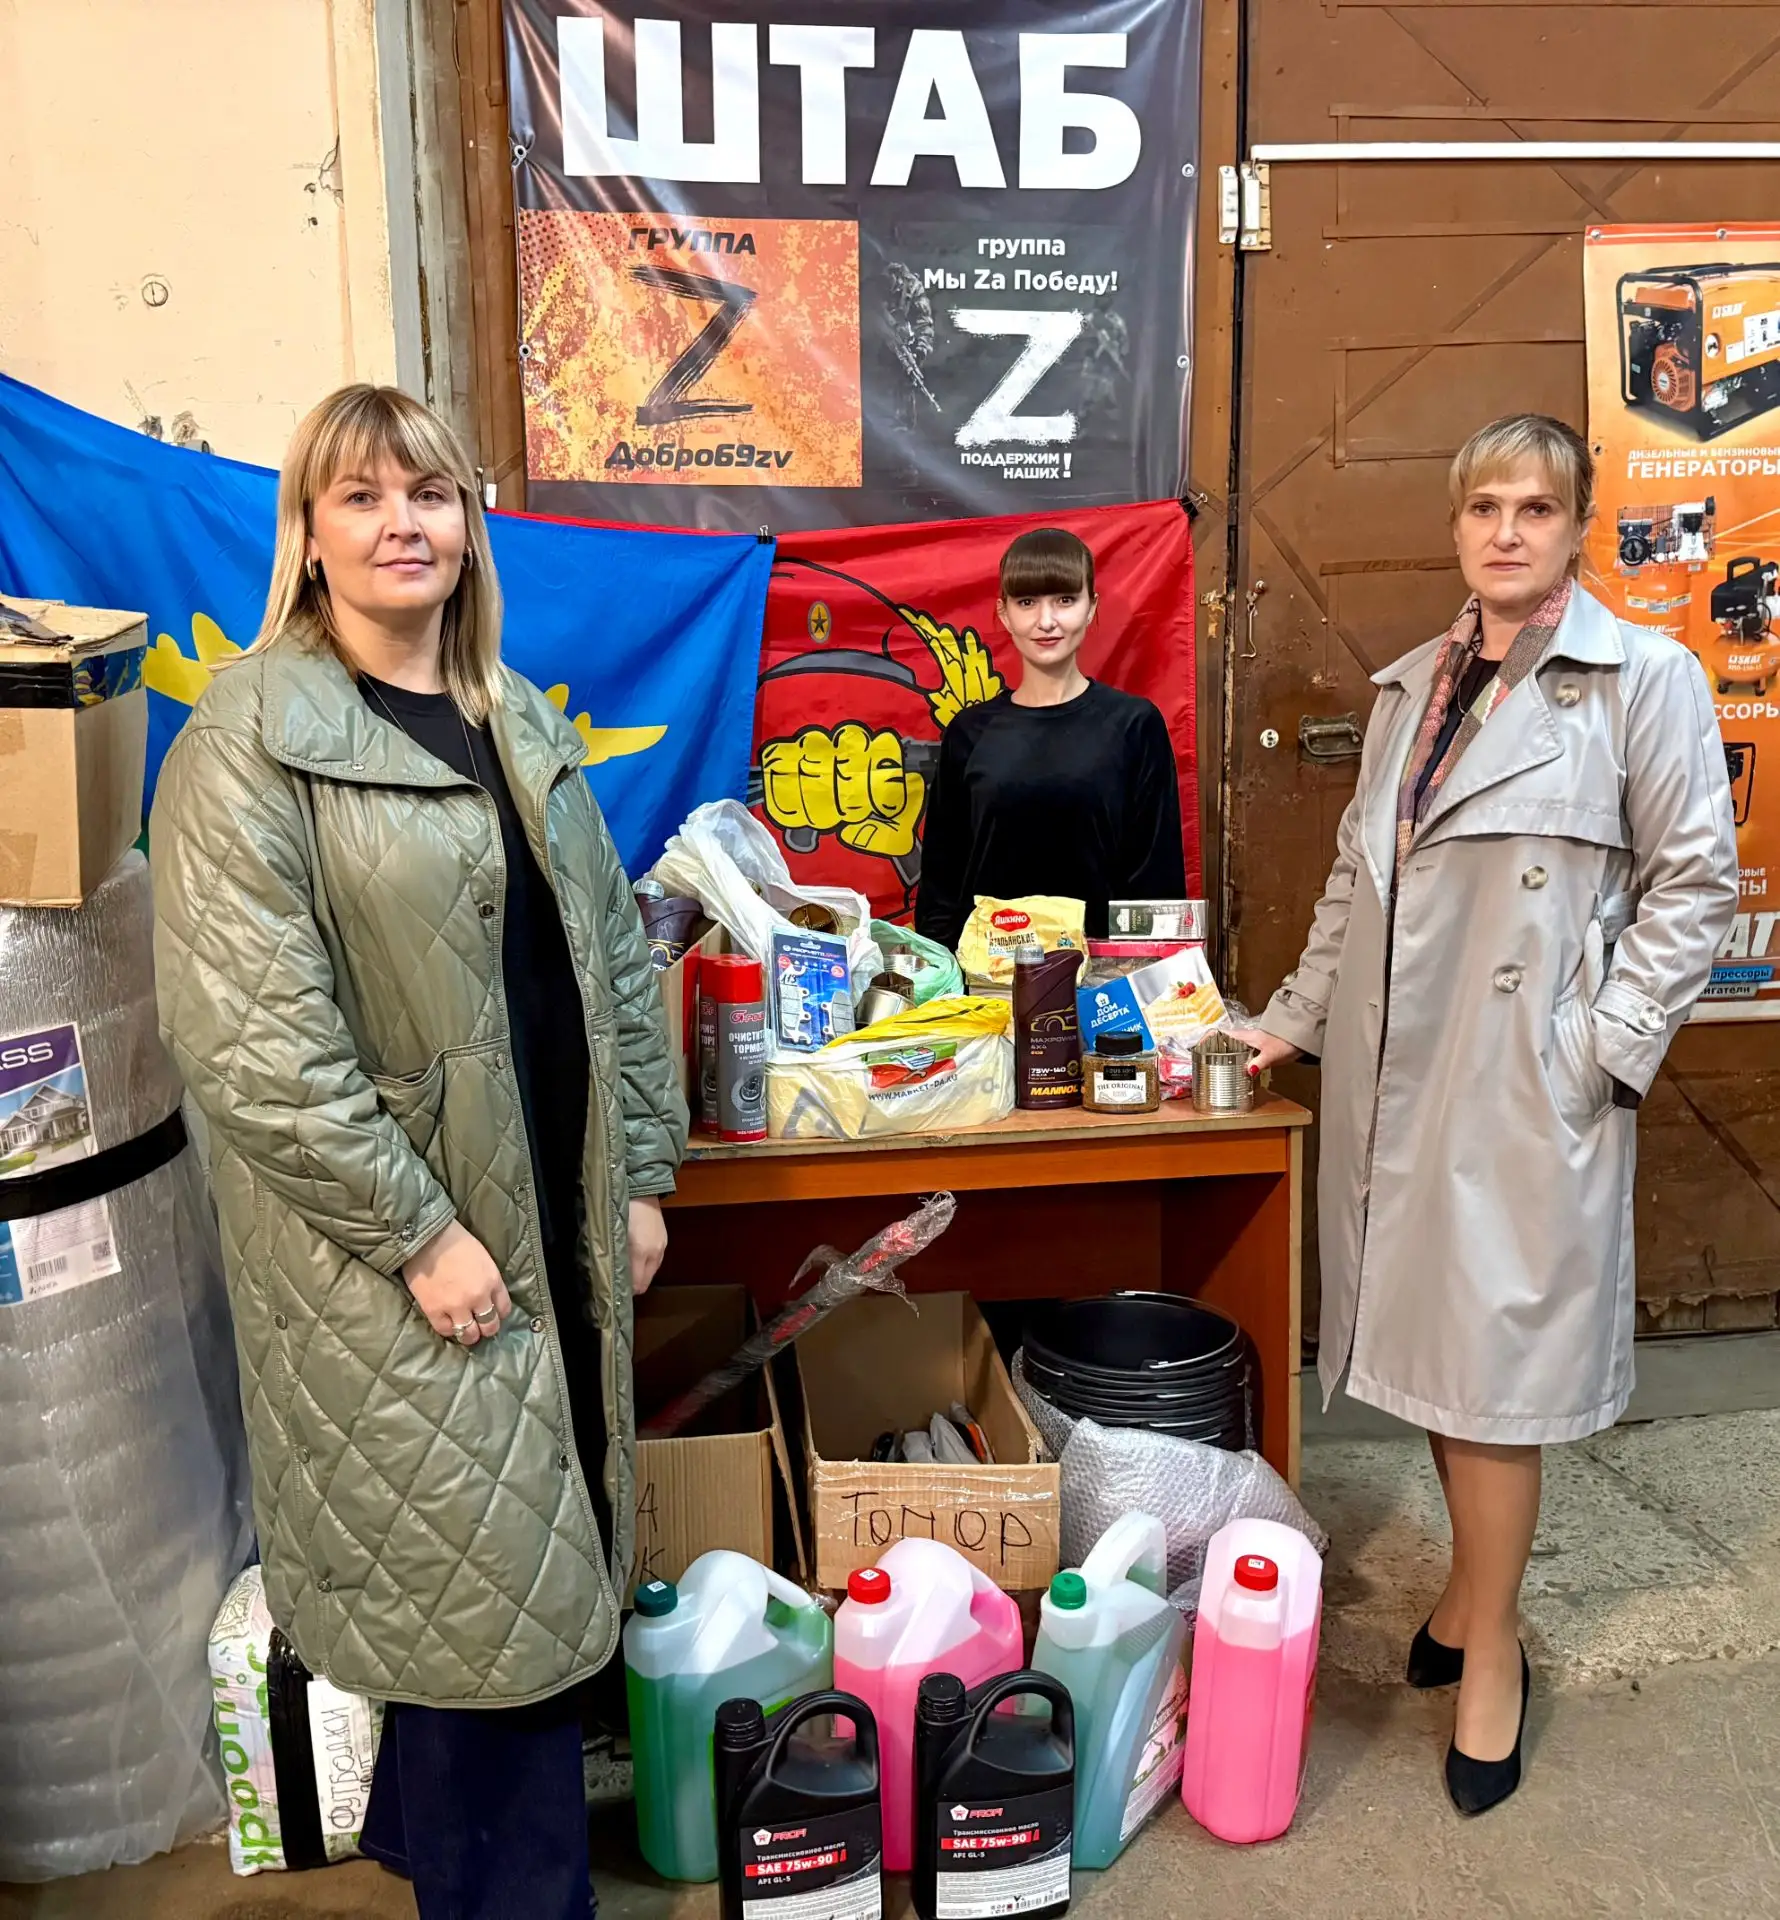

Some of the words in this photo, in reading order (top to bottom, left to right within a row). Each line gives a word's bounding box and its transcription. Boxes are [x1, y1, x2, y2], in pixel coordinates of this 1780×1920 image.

[557, 16, 1141, 189] ШТАБ
[628, 228, 757, 255] ГРУППА
[977, 237, 1066, 259] группа
[923, 268, 966, 290] Мы
[1014, 269, 1119, 295] Победу!
[960, 452, 1060, 466] ПОДДЕРЖИМ
[1003, 467, 1060, 480] НАШИХ
[1097, 1002, 1118, 1017] ДОМ
[1090, 1007, 1131, 1028] ДЕСЕРТА
[1030, 1084, 1079, 1096] MANNOL
[1111, 1082, 1144, 1092] ORIGINAL
[953, 1838, 977, 1849] SAE
[757, 1862, 782, 1876] SAE
[757, 1877, 772, 1886] API
